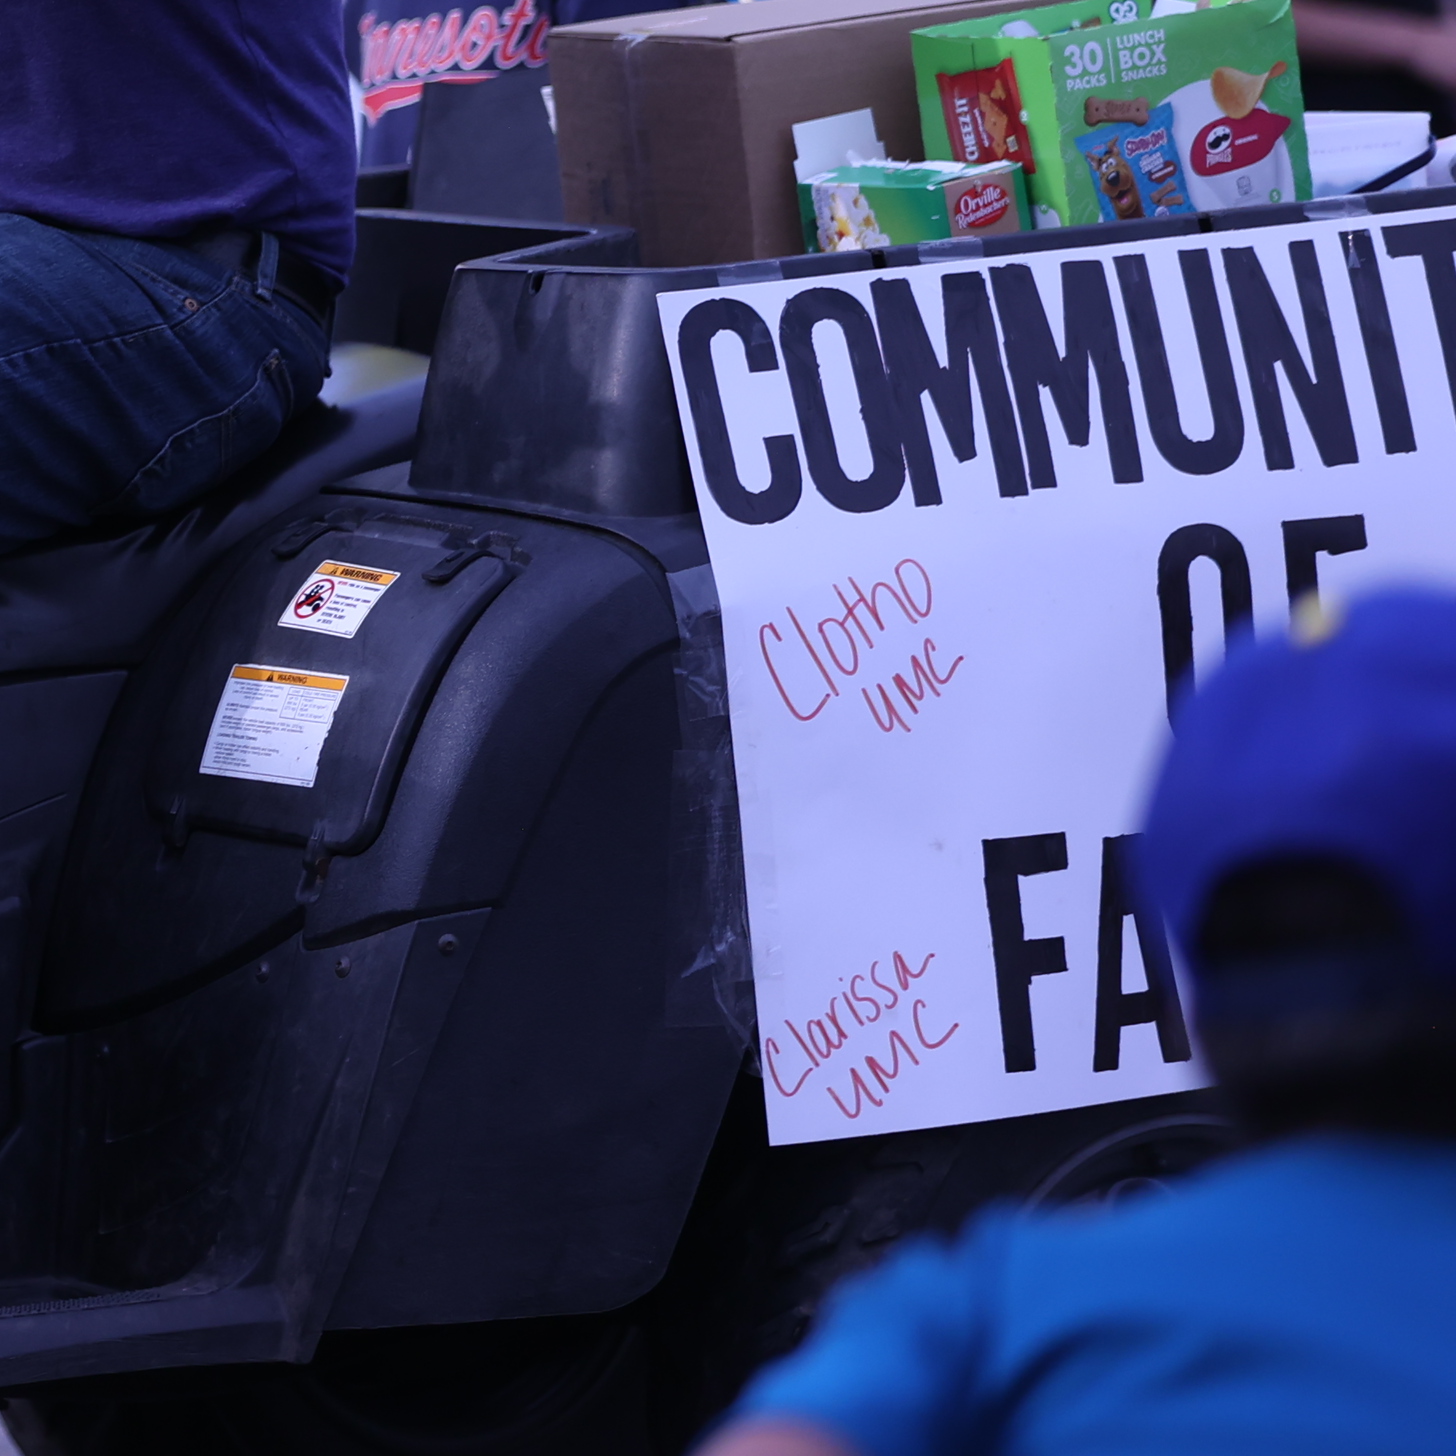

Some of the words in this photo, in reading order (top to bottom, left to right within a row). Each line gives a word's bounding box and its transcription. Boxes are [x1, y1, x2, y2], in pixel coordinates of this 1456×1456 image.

[1116, 29, 1165, 49] LUNCH
[1064, 41, 1104, 77] 30
[1119, 43, 1167, 69] BOX
[1066, 73, 1107, 92] PACKS
[1121, 64, 1167, 82] SNACKS
[960, 185, 1001, 215] Orville
[339, 567, 382, 582] WARNING
[277, 674, 308, 685] WARNING
[764, 950, 935, 1097] Clarissa
